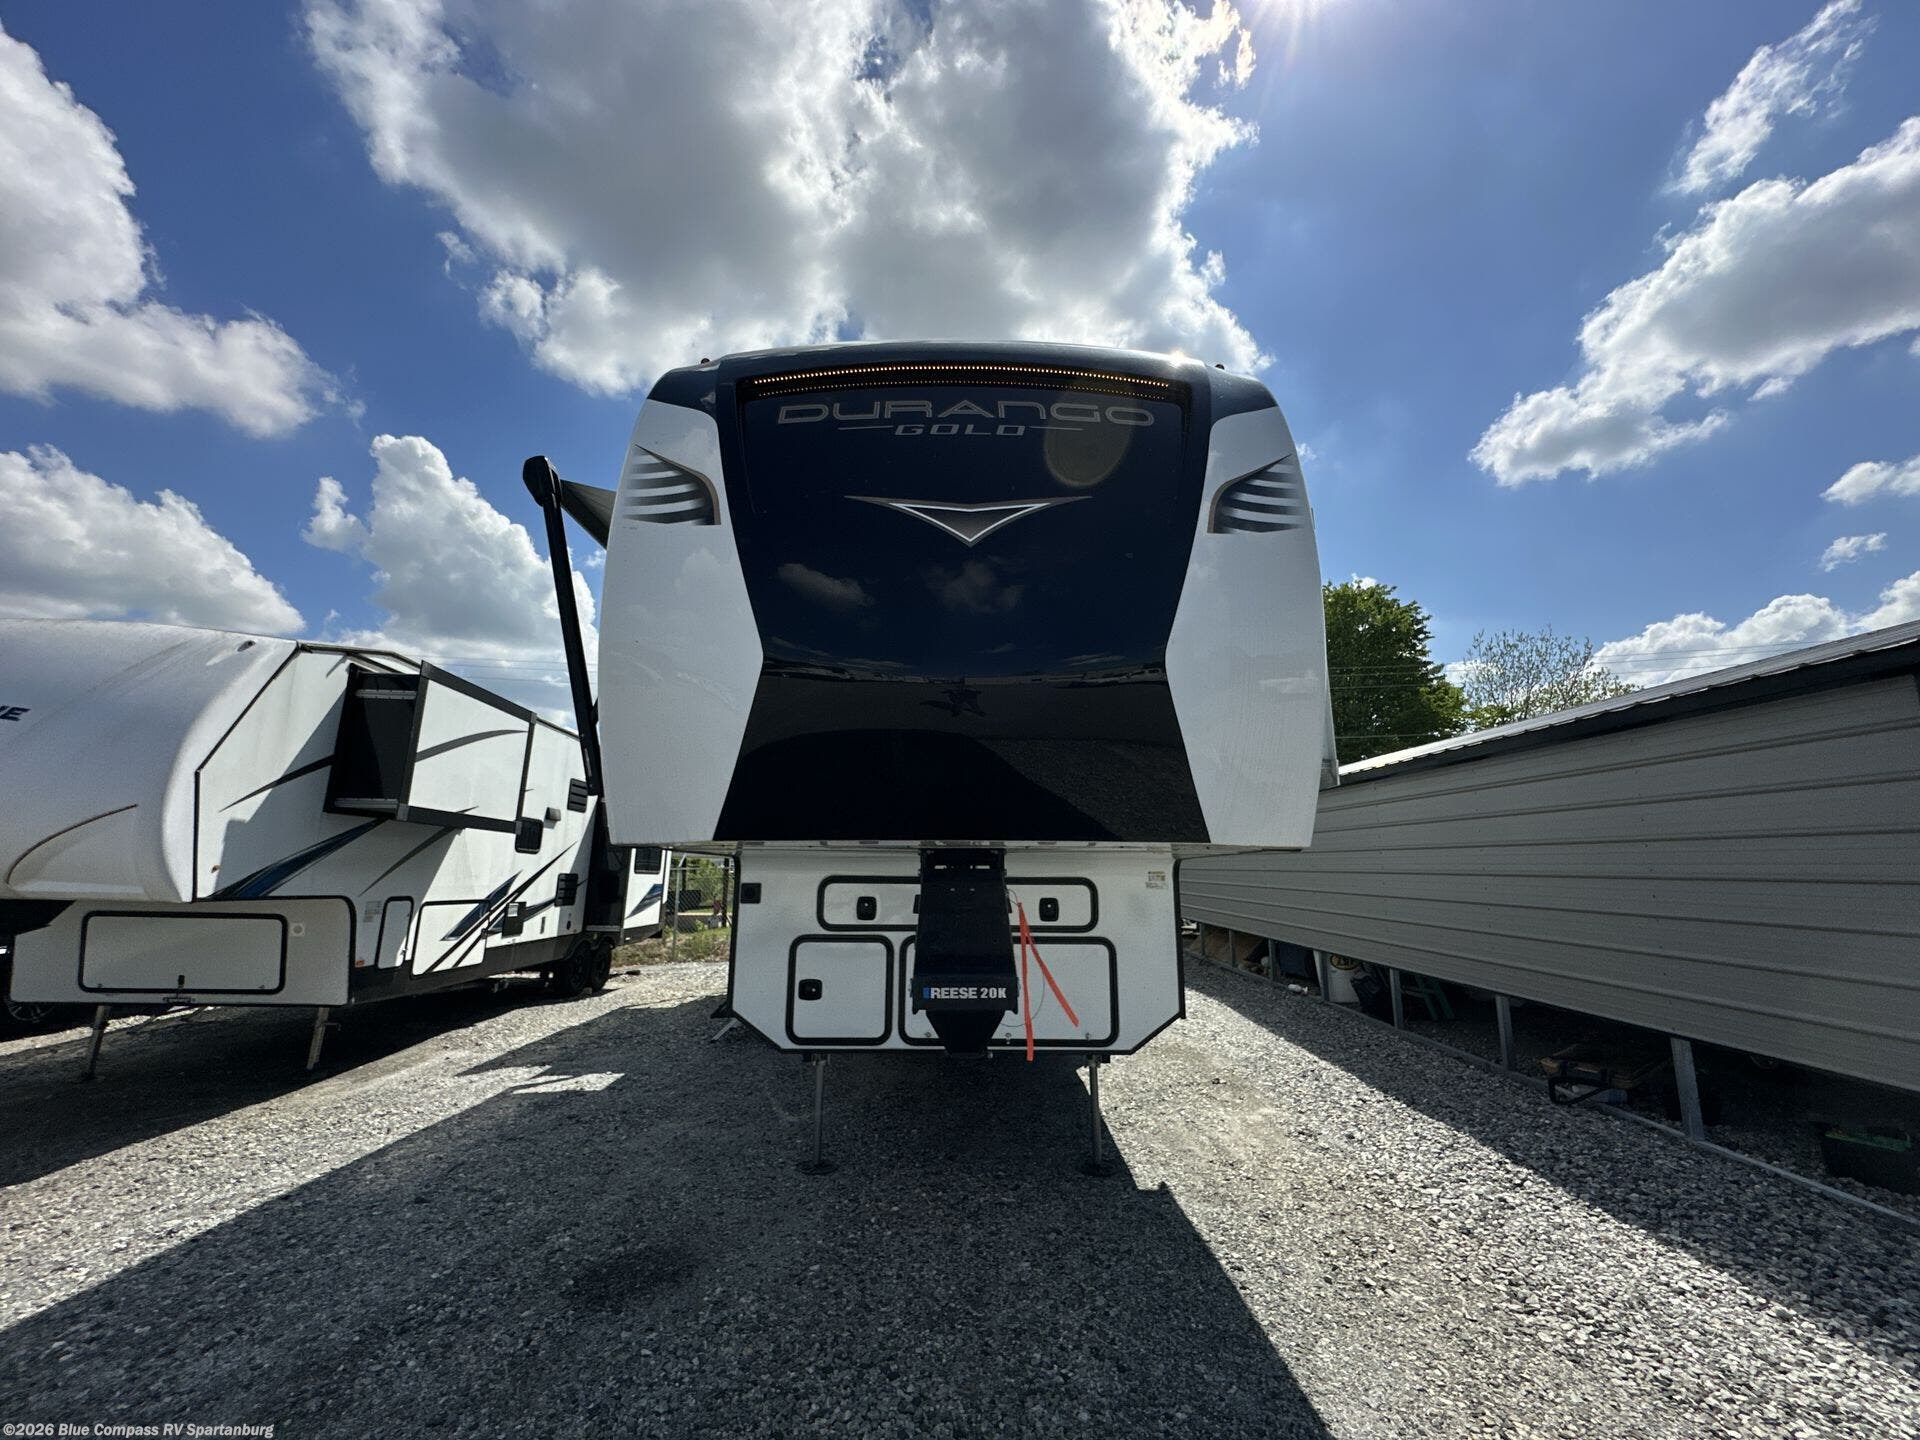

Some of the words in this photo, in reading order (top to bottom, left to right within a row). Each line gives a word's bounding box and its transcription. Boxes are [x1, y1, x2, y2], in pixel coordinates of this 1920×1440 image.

[778, 400, 1155, 426] DURANGO
[895, 424, 1026, 437] GOLD
[930, 987, 978, 999] REESE
[981, 987, 1007, 999] 20K
